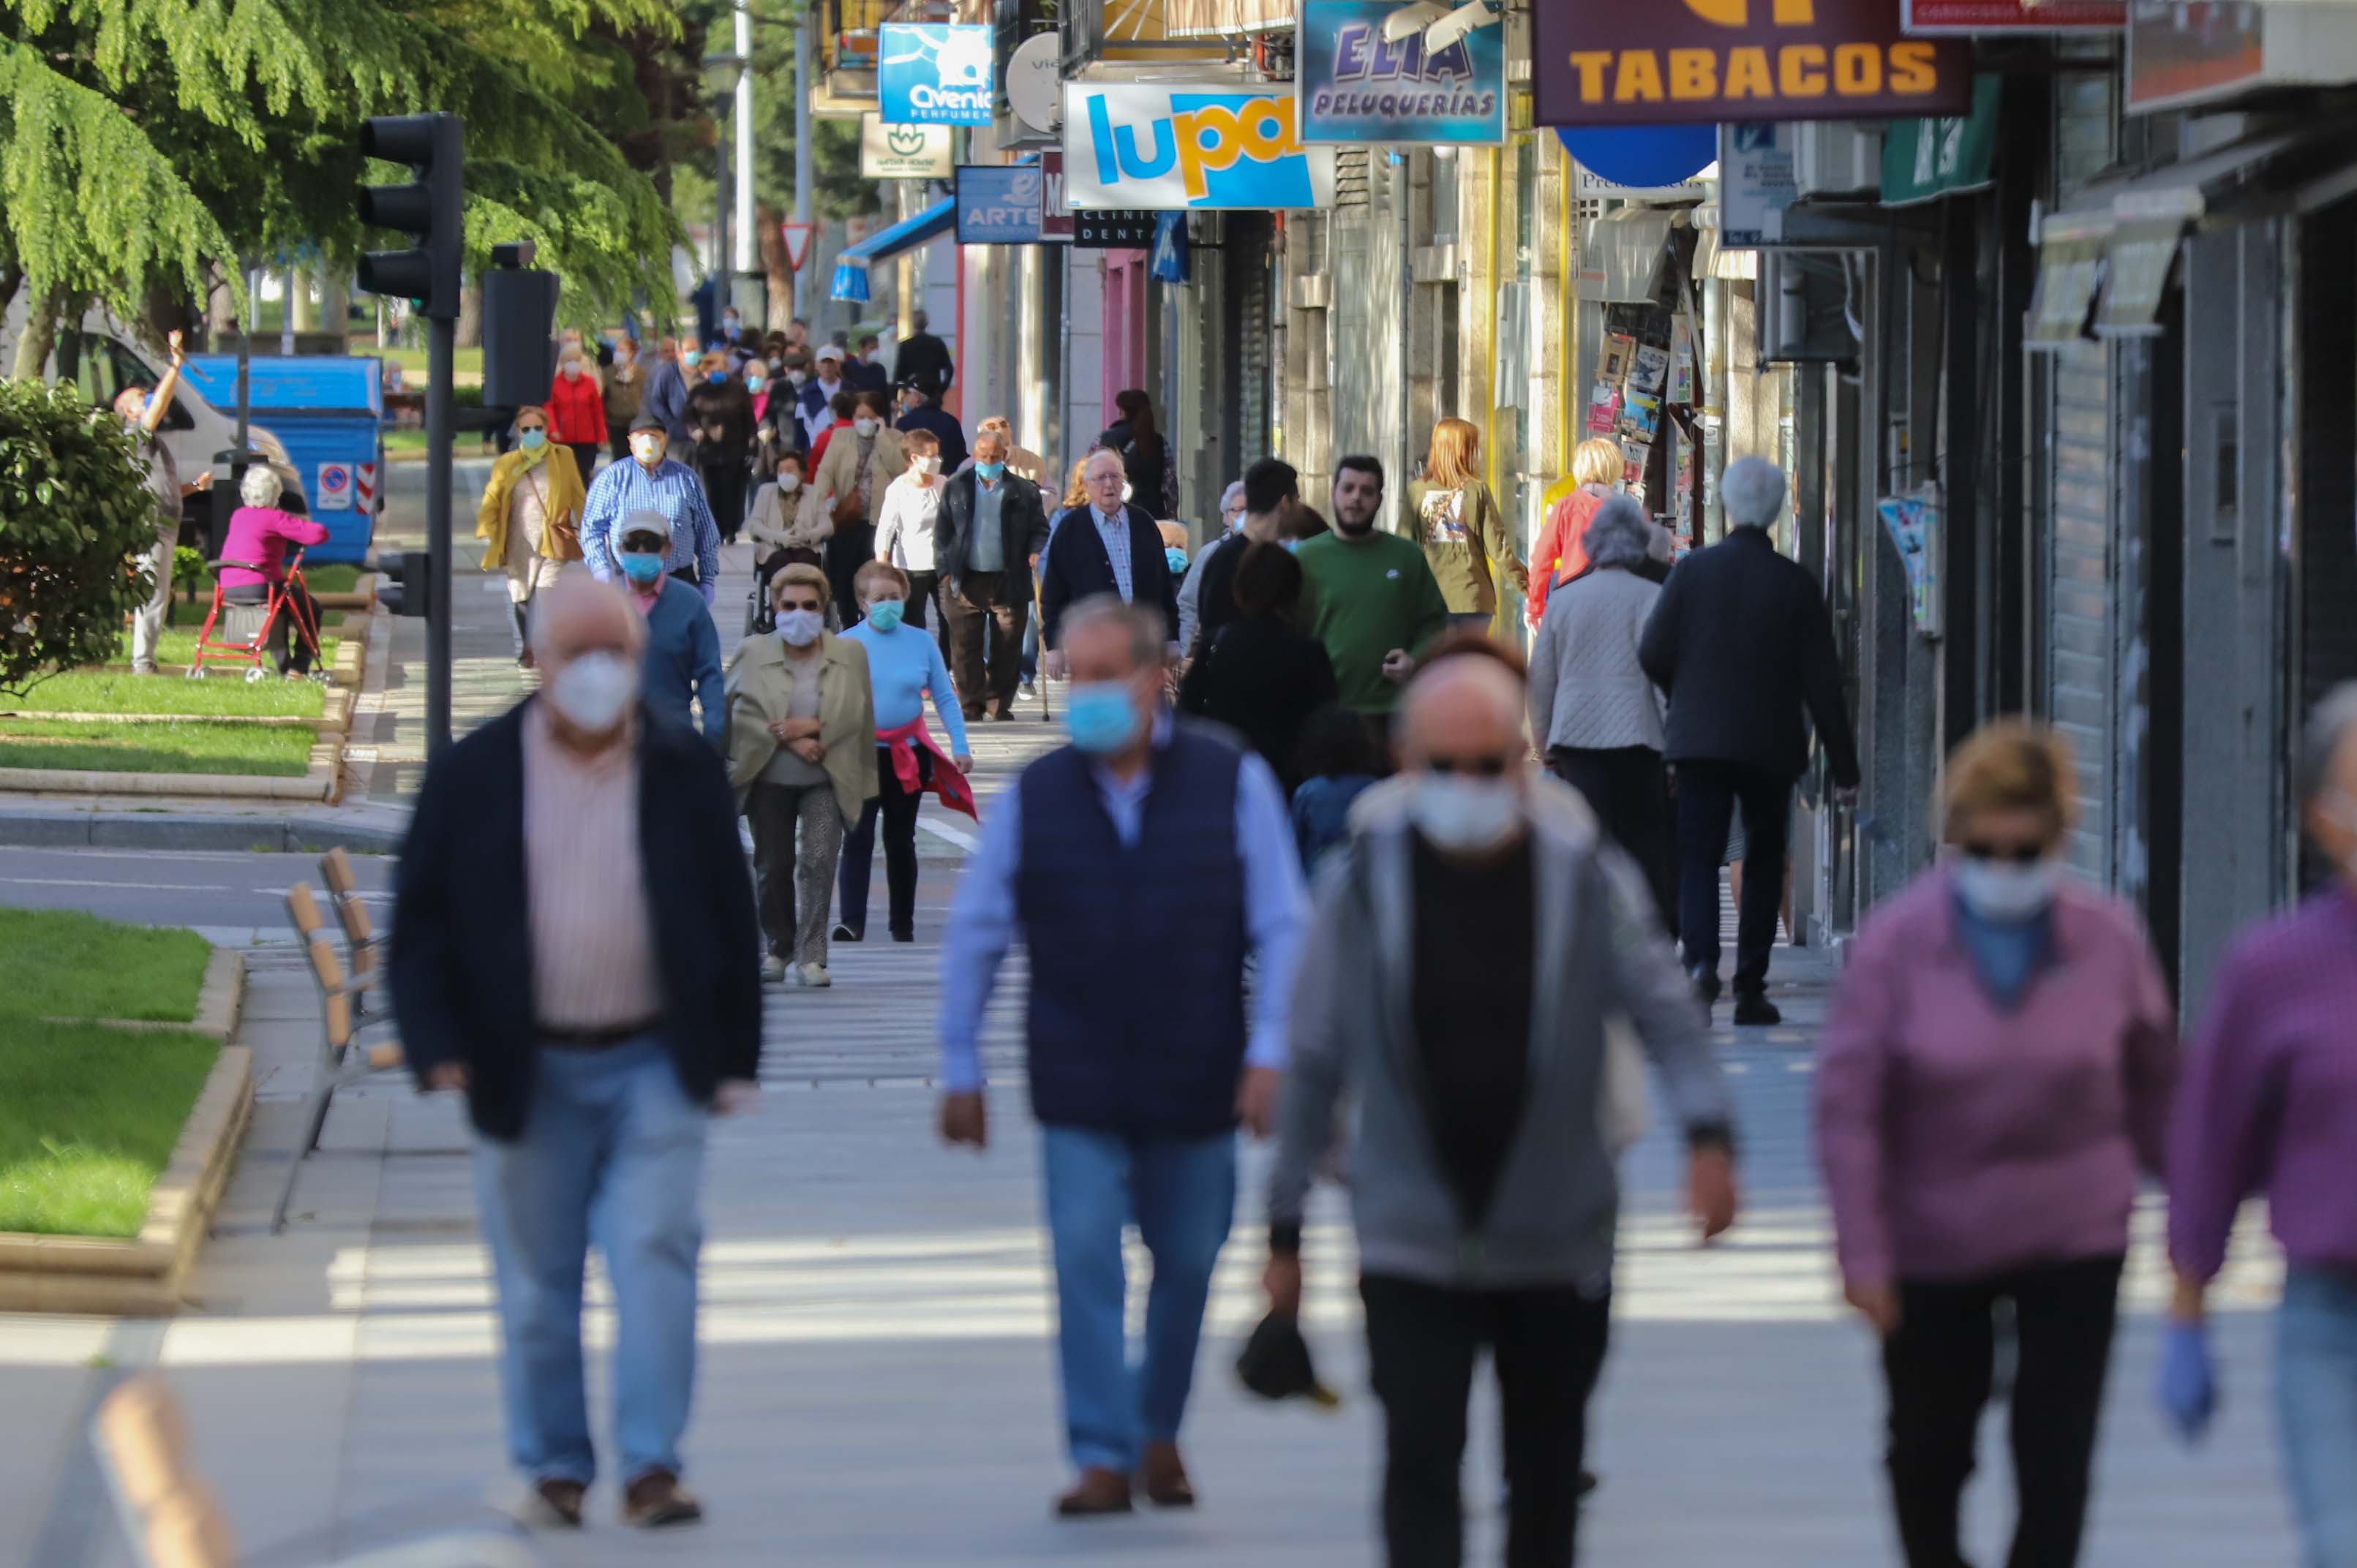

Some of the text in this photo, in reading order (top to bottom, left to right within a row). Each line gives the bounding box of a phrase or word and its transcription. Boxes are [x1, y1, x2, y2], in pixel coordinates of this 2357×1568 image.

[1335, 23, 1473, 83] ELIA
[1569, 42, 1937, 104] TABACOS
[1314, 83, 1495, 116] PELUQUERÍAS
[1086, 94, 1307, 198] lupa
